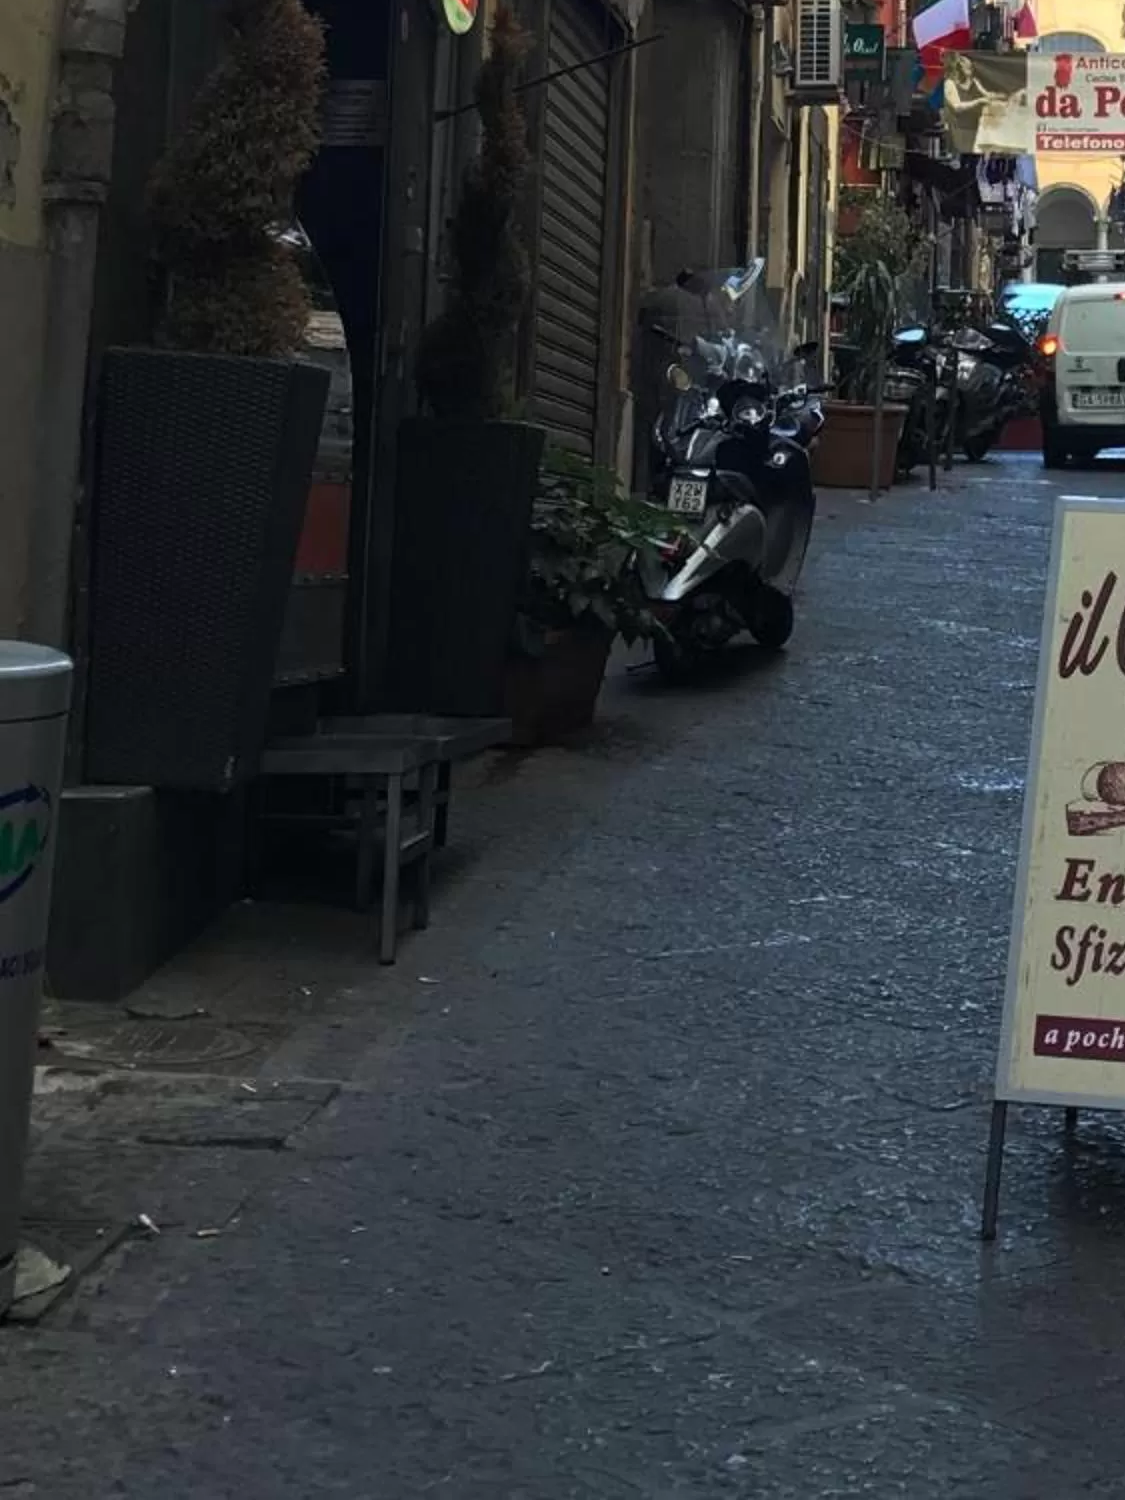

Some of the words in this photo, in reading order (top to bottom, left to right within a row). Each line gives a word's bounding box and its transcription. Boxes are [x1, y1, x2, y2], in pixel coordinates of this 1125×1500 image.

[1035, 86, 1081, 119] da
[1040, 137, 1125, 150] Telefono
[1058, 570, 1119, 680] il
[1044, 1028, 1058, 1045] a
